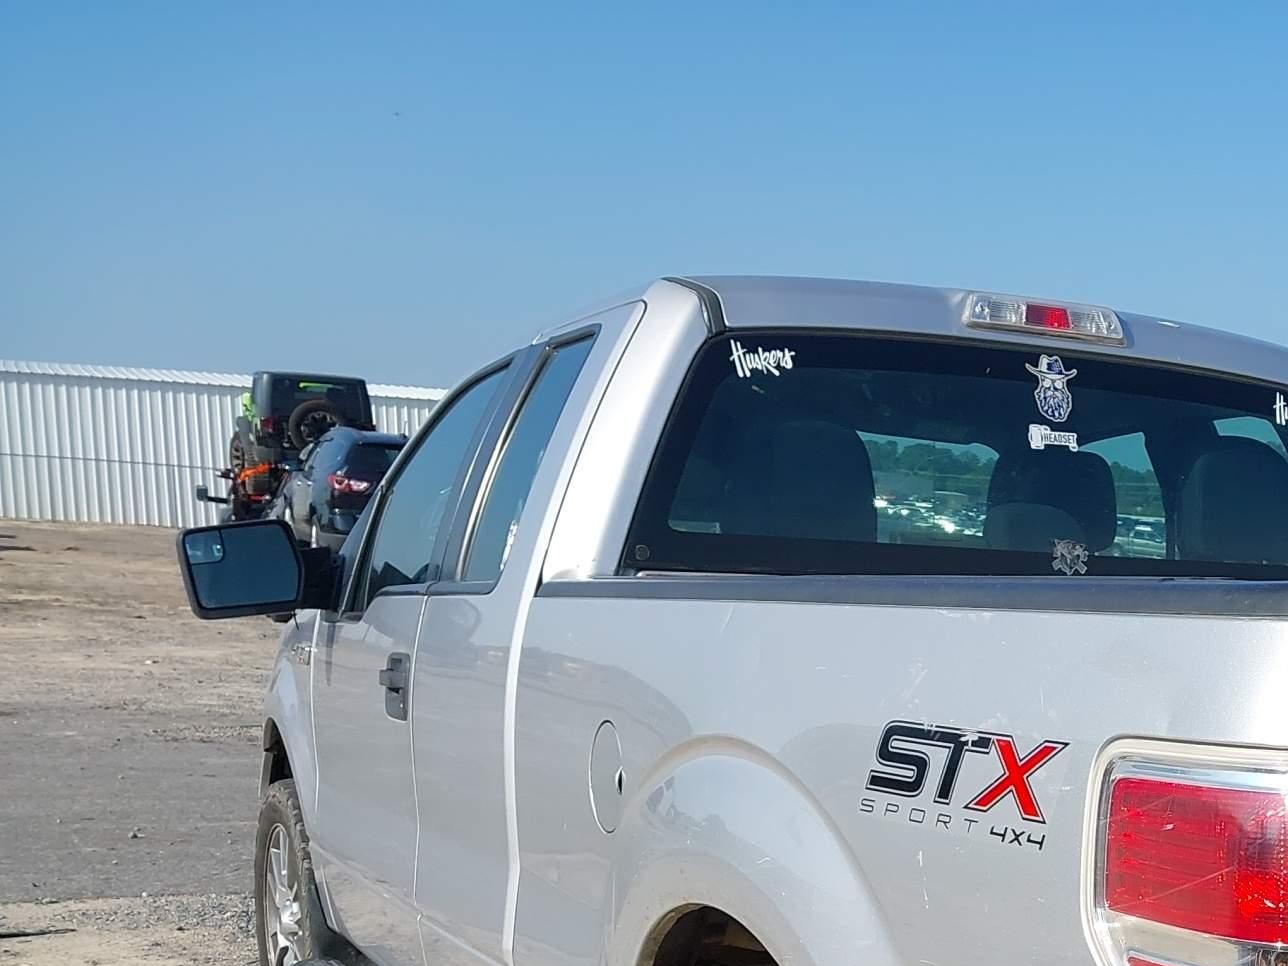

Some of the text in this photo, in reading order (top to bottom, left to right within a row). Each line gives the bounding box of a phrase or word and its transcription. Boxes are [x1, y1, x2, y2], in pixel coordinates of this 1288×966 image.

[729, 339, 796, 378] Huskers
[1043, 432, 1075, 445] HEADSET
[865, 719, 1071, 824] STX
[859, 797, 979, 834] SPORT
